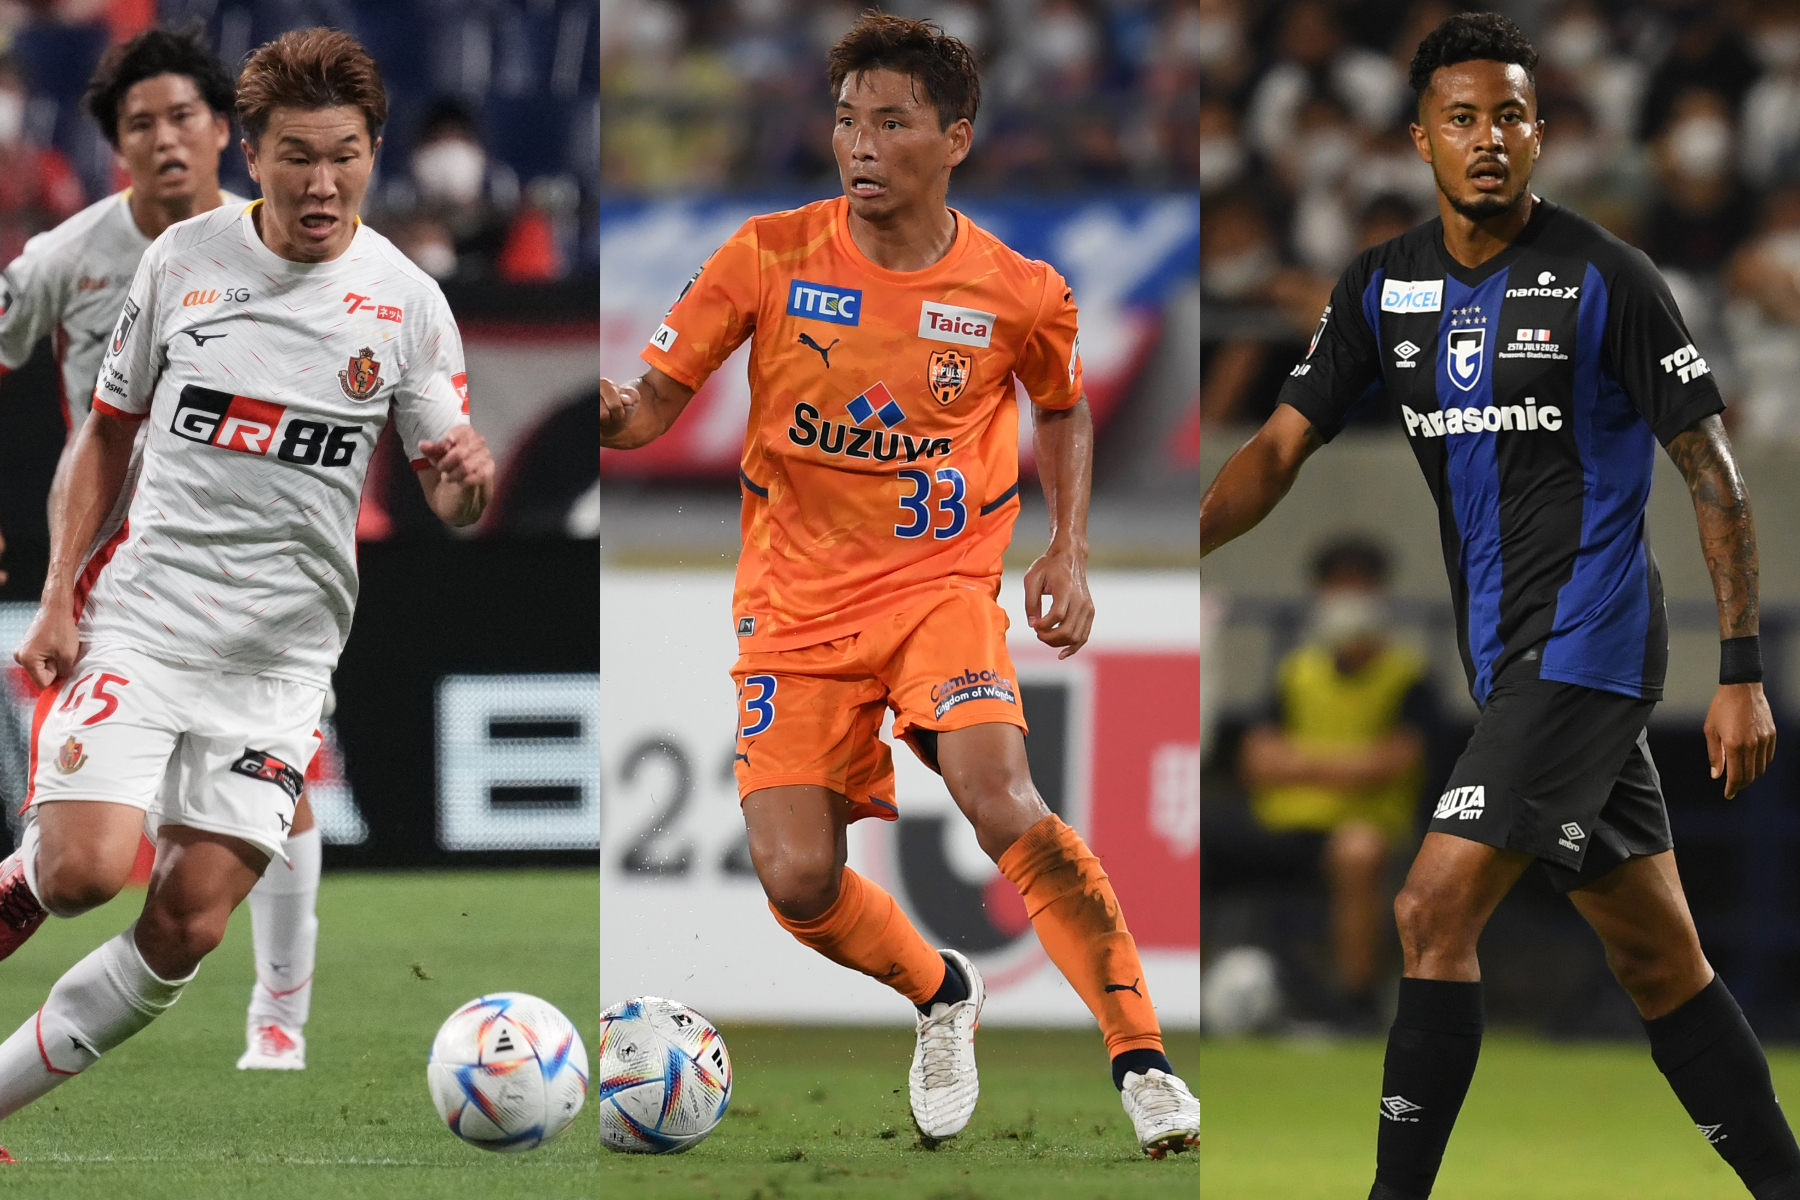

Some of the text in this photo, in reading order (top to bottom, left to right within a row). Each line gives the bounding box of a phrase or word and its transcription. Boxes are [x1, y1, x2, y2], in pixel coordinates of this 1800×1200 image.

[182, 287, 251, 307] au 5G
[794, 286, 856, 319] ITEC
[926, 310, 988, 338] Taica
[1498, 351, 1569, 361] Panasonic Stadium Suita
[1507, 342, 1560, 353] 25TH JULY 2022
[1676, 357, 1711, 385] TIR
[1400, 396, 1563, 439] Panasonic
[277, 418, 364, 468] 86
[893, 466, 968, 541] 33
[734, 674, 778, 738] 3
[935, 691, 970, 718] Kingdom
[971, 686, 983, 698] of
[1459, 808, 1483, 820] CITY
[1558, 837, 1580, 852] umbro
